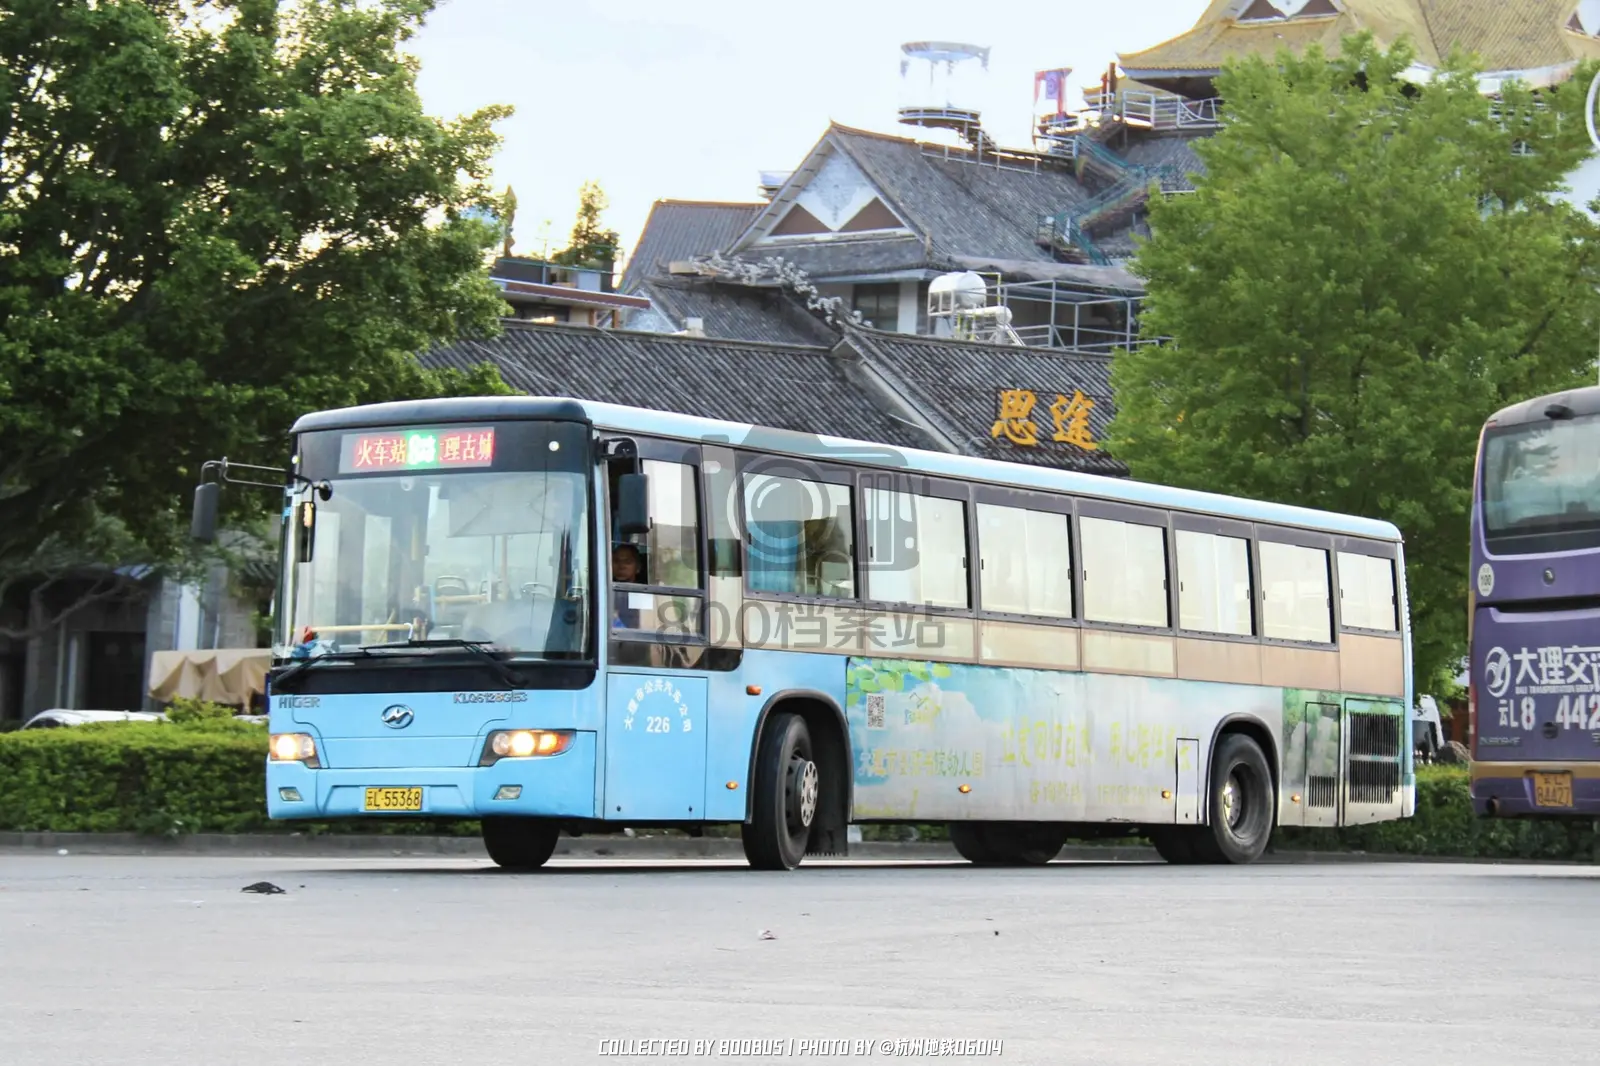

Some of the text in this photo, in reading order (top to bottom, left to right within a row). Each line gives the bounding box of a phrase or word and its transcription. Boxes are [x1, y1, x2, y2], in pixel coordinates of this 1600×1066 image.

[356, 438, 406, 467] 火车站
[279, 697, 321, 708] HIGER
[646, 716, 670, 733] 226
